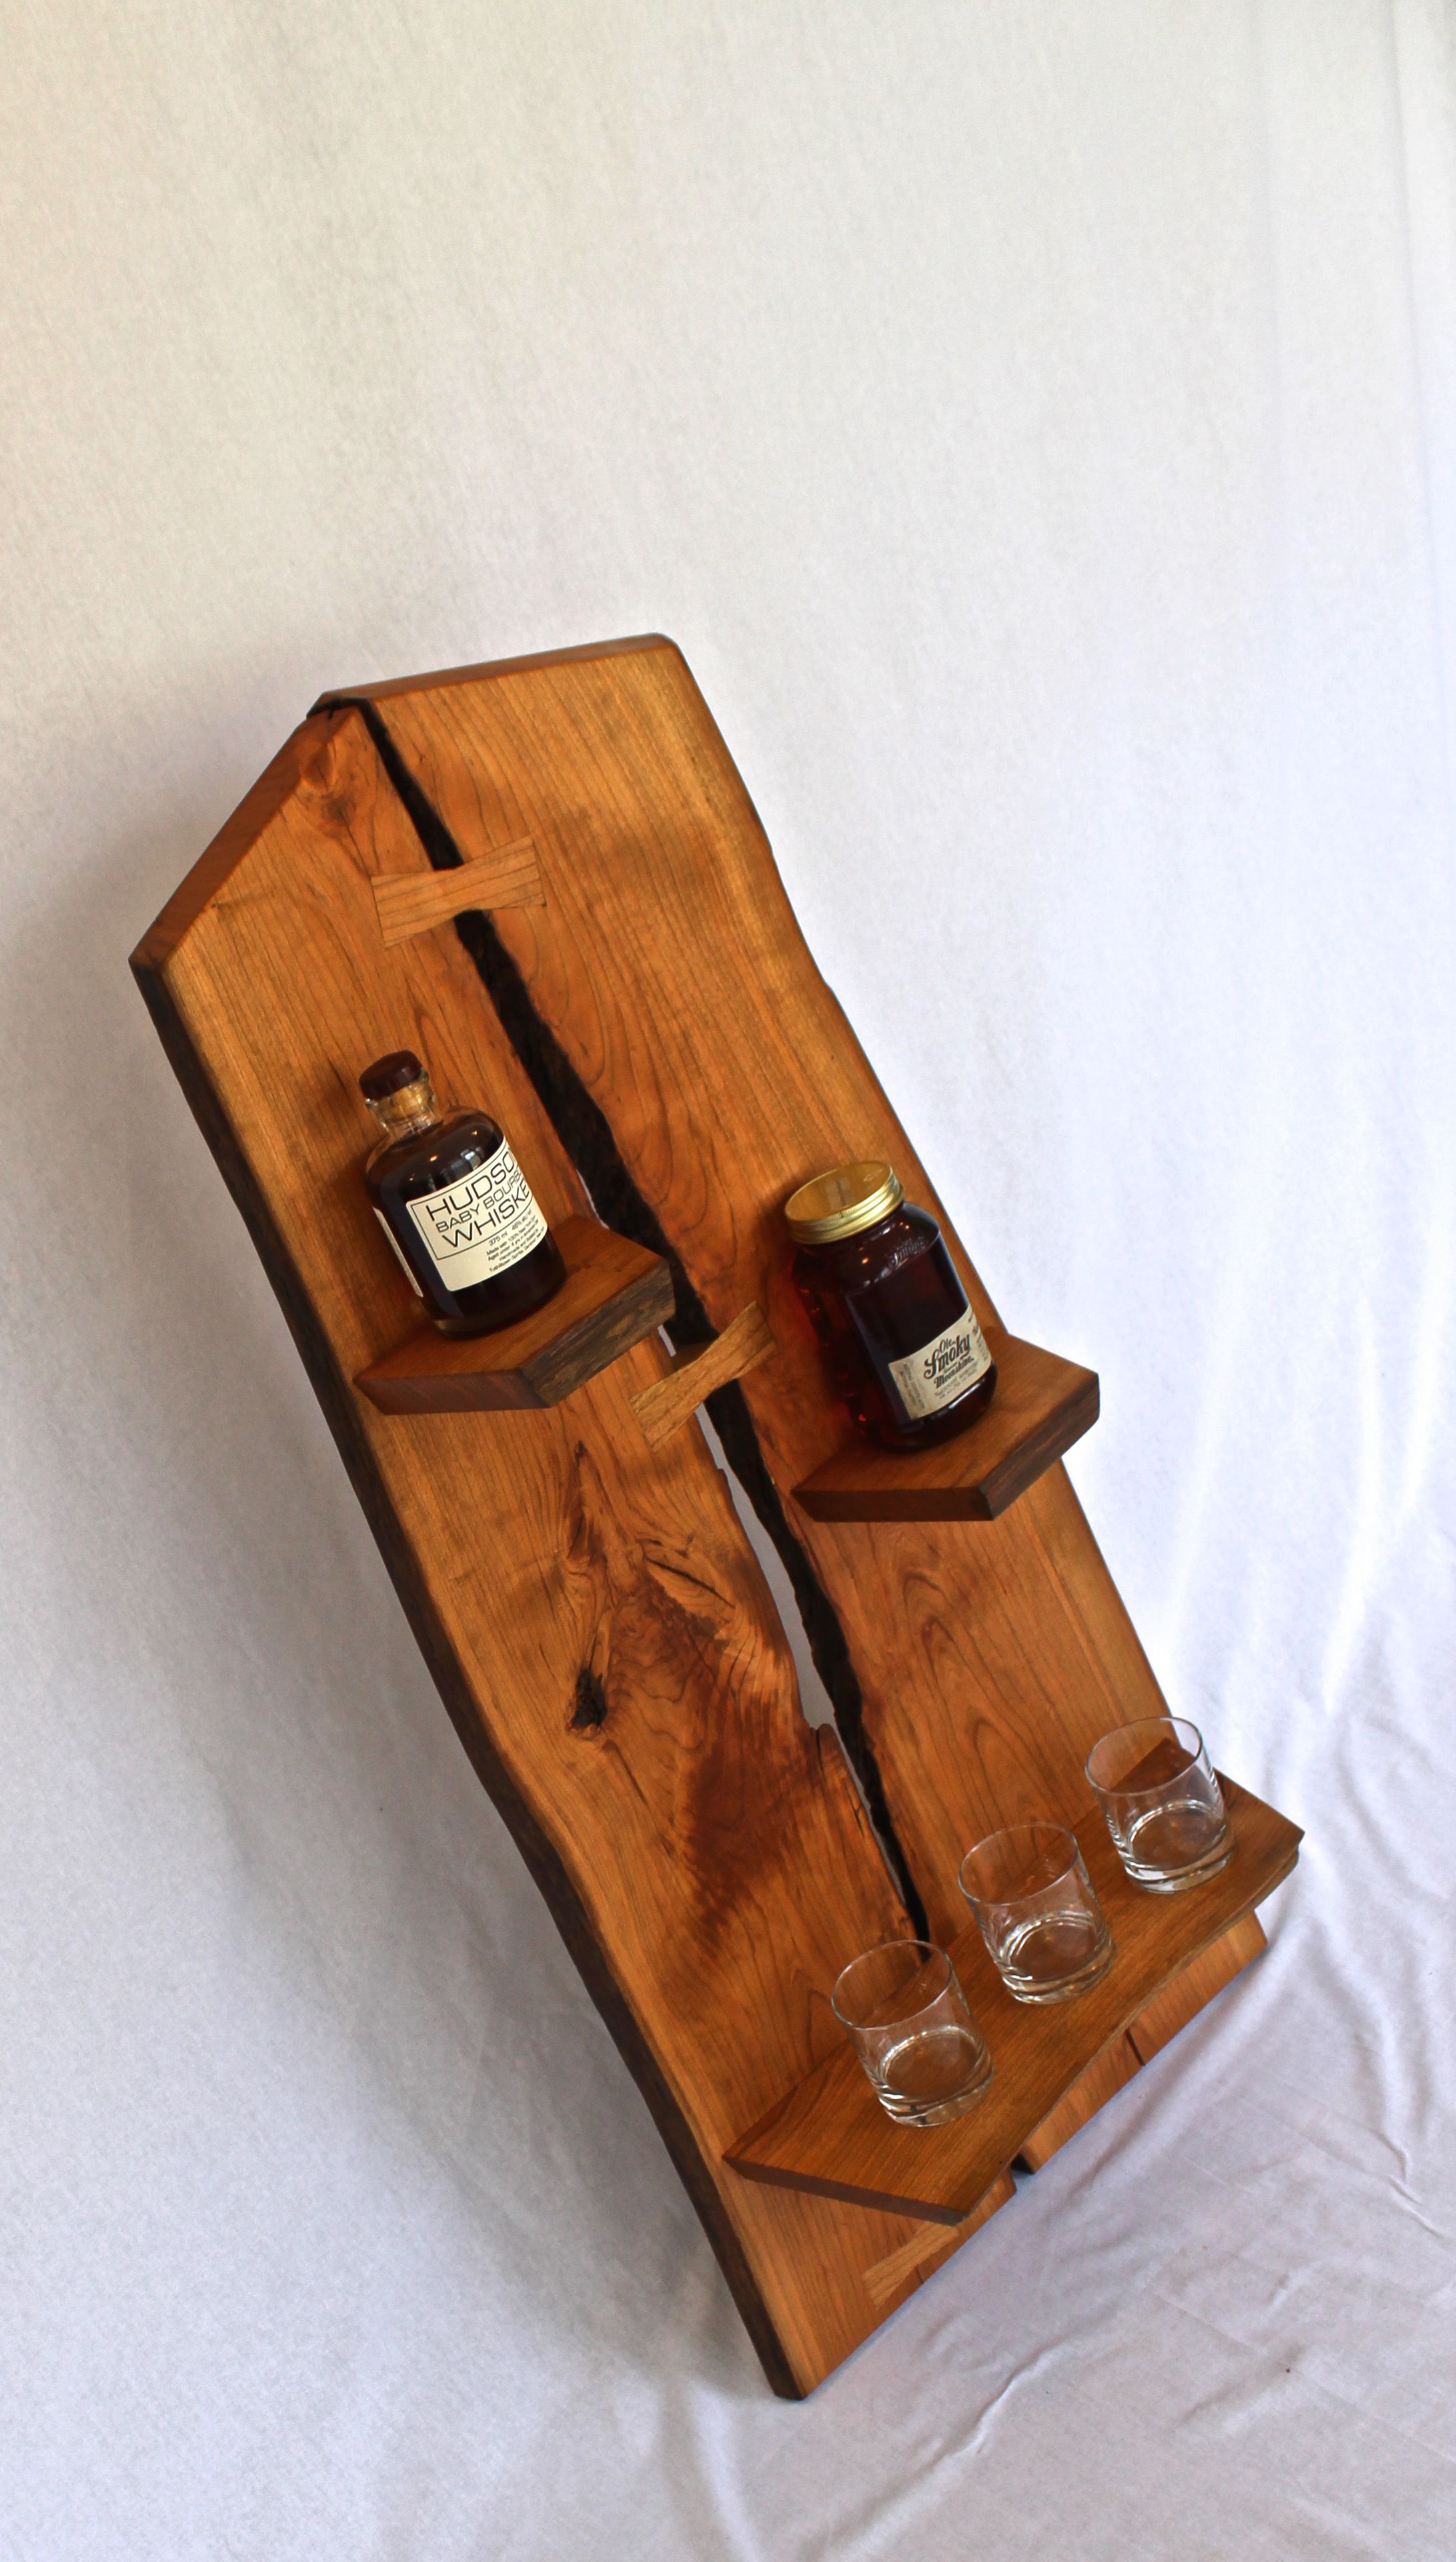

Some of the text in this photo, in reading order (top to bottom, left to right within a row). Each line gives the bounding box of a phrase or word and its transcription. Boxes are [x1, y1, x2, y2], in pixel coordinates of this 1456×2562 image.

[426, 1148, 516, 1222] HUDSO
[436, 1164, 521, 1232] BABY BOURB
[489, 1236, 501, 1246] 375
[924, 1334, 971, 1379] Smoky
[939, 1338, 956, 1353] Ole
